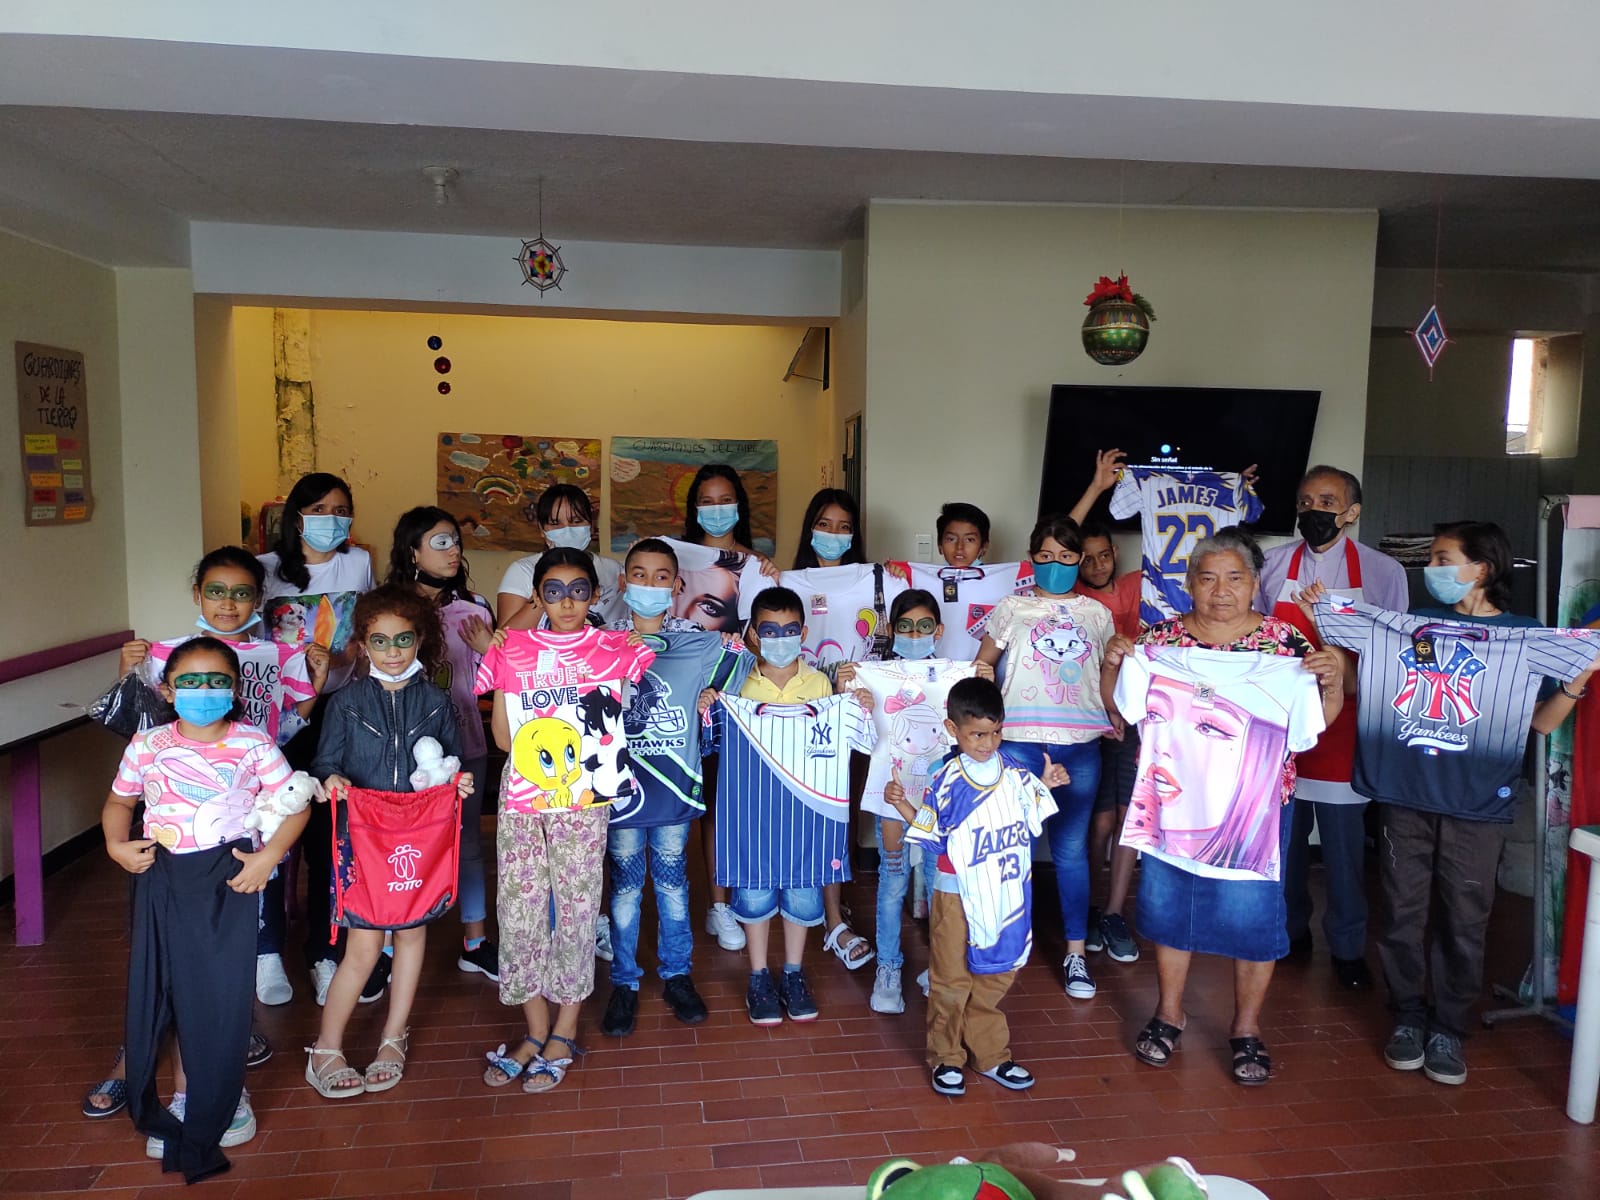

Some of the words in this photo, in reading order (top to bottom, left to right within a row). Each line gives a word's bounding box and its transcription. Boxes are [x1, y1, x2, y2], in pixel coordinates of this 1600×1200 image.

[39, 385, 51, 404] DE
[1157, 484, 1218, 509] JAMES
[241, 660, 280, 684] OVE
[516, 666, 577, 690] TRUE
[521, 686, 578, 711] LOVE
[1398, 718, 1469, 743] Yankees
[627, 738, 685, 749] HAWKS
[998, 853, 1021, 883] 23
[387, 879, 422, 892] TOTTO
